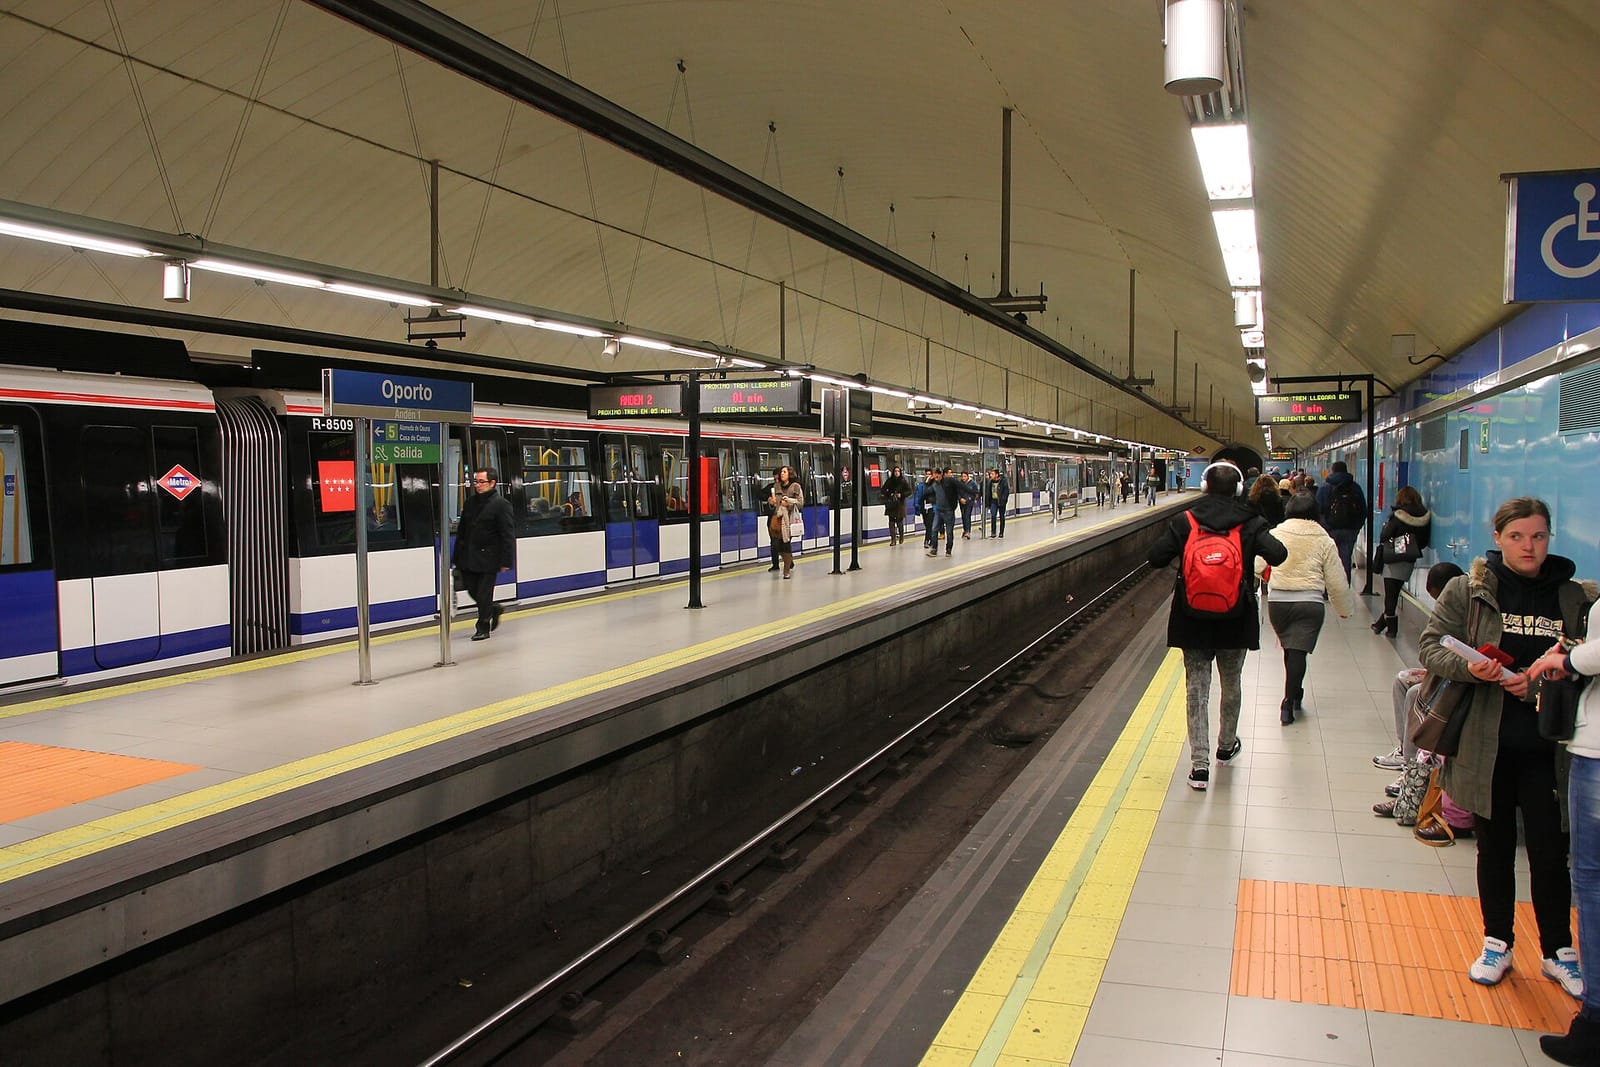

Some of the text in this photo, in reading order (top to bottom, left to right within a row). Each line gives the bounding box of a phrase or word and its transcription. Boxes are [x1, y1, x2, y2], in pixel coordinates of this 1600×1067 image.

[382, 379, 432, 404] Oporto
[647, 394, 653, 405] 2
[732, 392, 764, 404] 01 min
[597, 408, 622, 416] PROXIMO
[1292, 403, 1323, 413] 01 min
[312, 418, 354, 431] R-8509
[388, 425, 395, 439] 5
[393, 446, 423, 458] Salida
[169, 478, 191, 486] Metro
